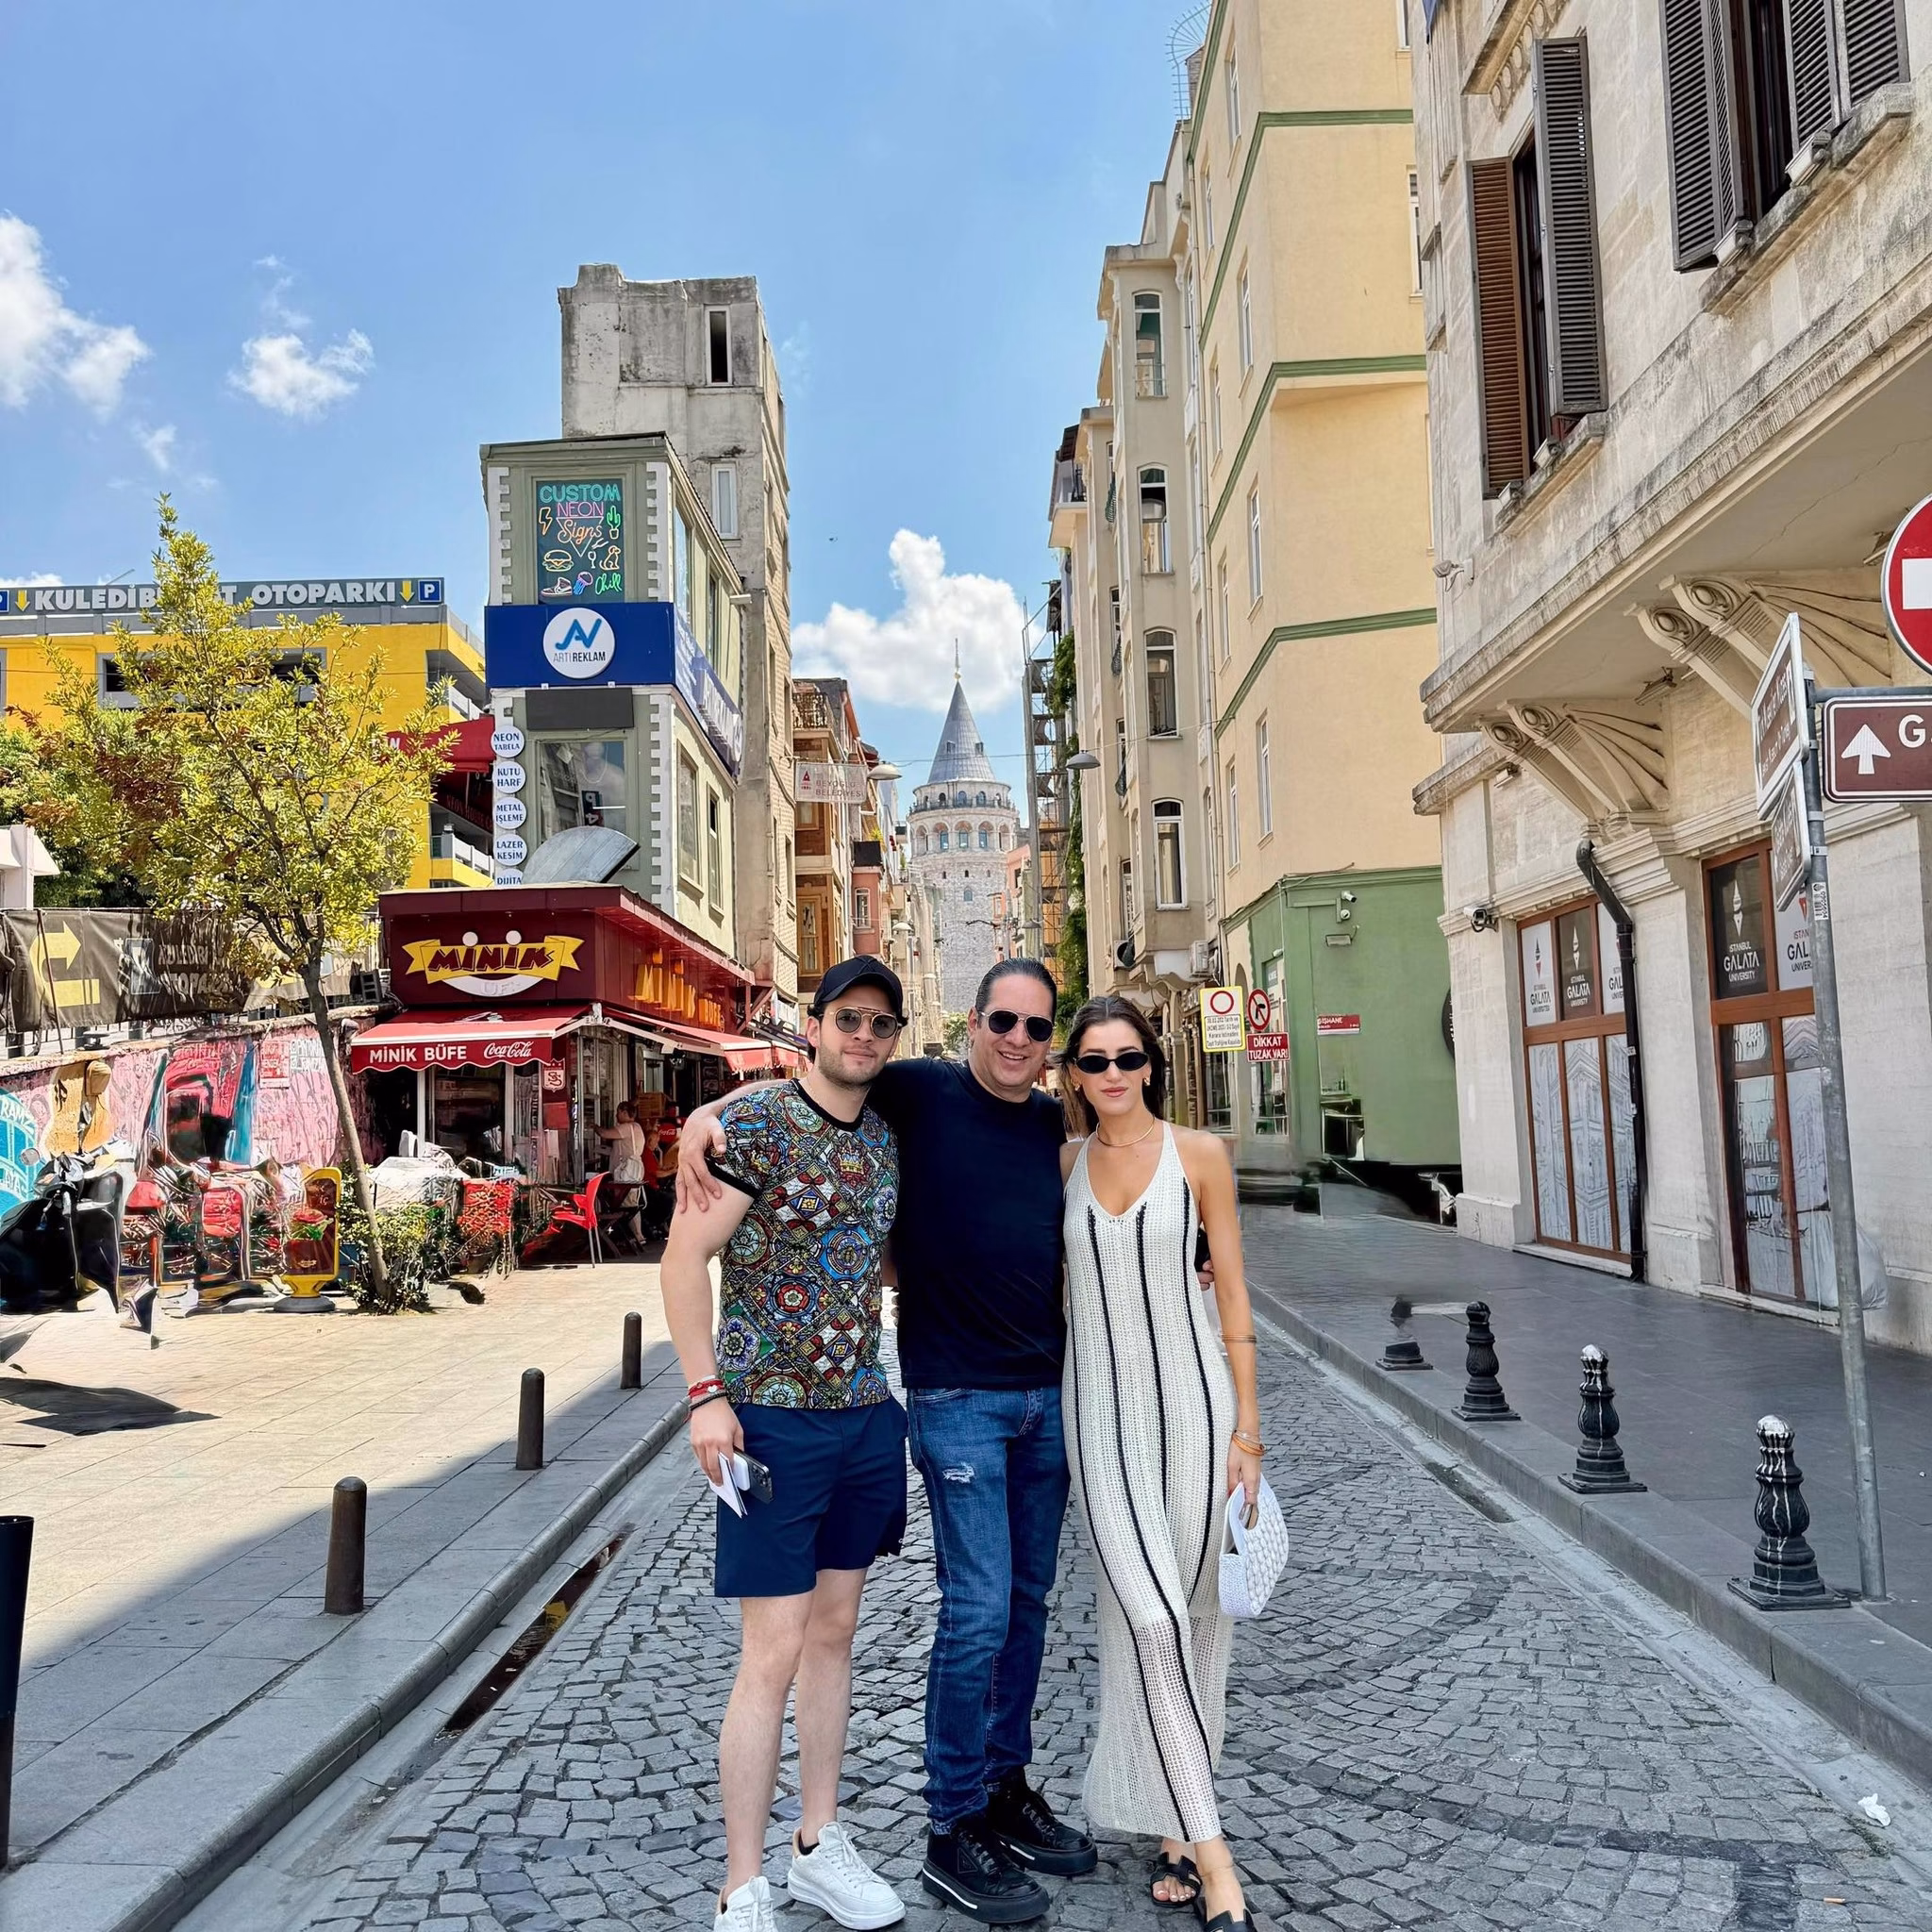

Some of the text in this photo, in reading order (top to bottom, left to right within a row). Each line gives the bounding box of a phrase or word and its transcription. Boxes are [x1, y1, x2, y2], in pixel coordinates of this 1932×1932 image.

[540, 484, 621, 503] CUSTOM
[557, 502, 604, 517] NEON
[557, 520, 603, 544] Signs
[594, 573, 623, 594] Chill
[251, 580, 395, 606] OTOPARKI
[493, 732, 520, 741] NEON
[1898, 714, 1932, 748] G
[497, 768, 521, 776] KUTU
[497, 778, 522, 787] HARF
[496, 804, 523, 812] METAL
[496, 841, 524, 849] LAZER
[496, 850, 523, 860] KESİM
[496, 875, 522, 885] DİJİTA
[1787, 941, 1811, 960] GAL
[1724, 951, 1760, 972] GALATA
[1608, 975, 1623, 991] GAL
[1728, 971, 1756, 982] UNIVERSITY
[1567, 982, 1591, 999] GALATA
[1530, 991, 1551, 1006] GALATA
[1253, 1035, 1282, 1047] DİKKAT
[369, 1041, 534, 1063] MİNİK BÜFE Coca-Cola
[1249, 1048, 1289, 1059] TUZAK VAR!
